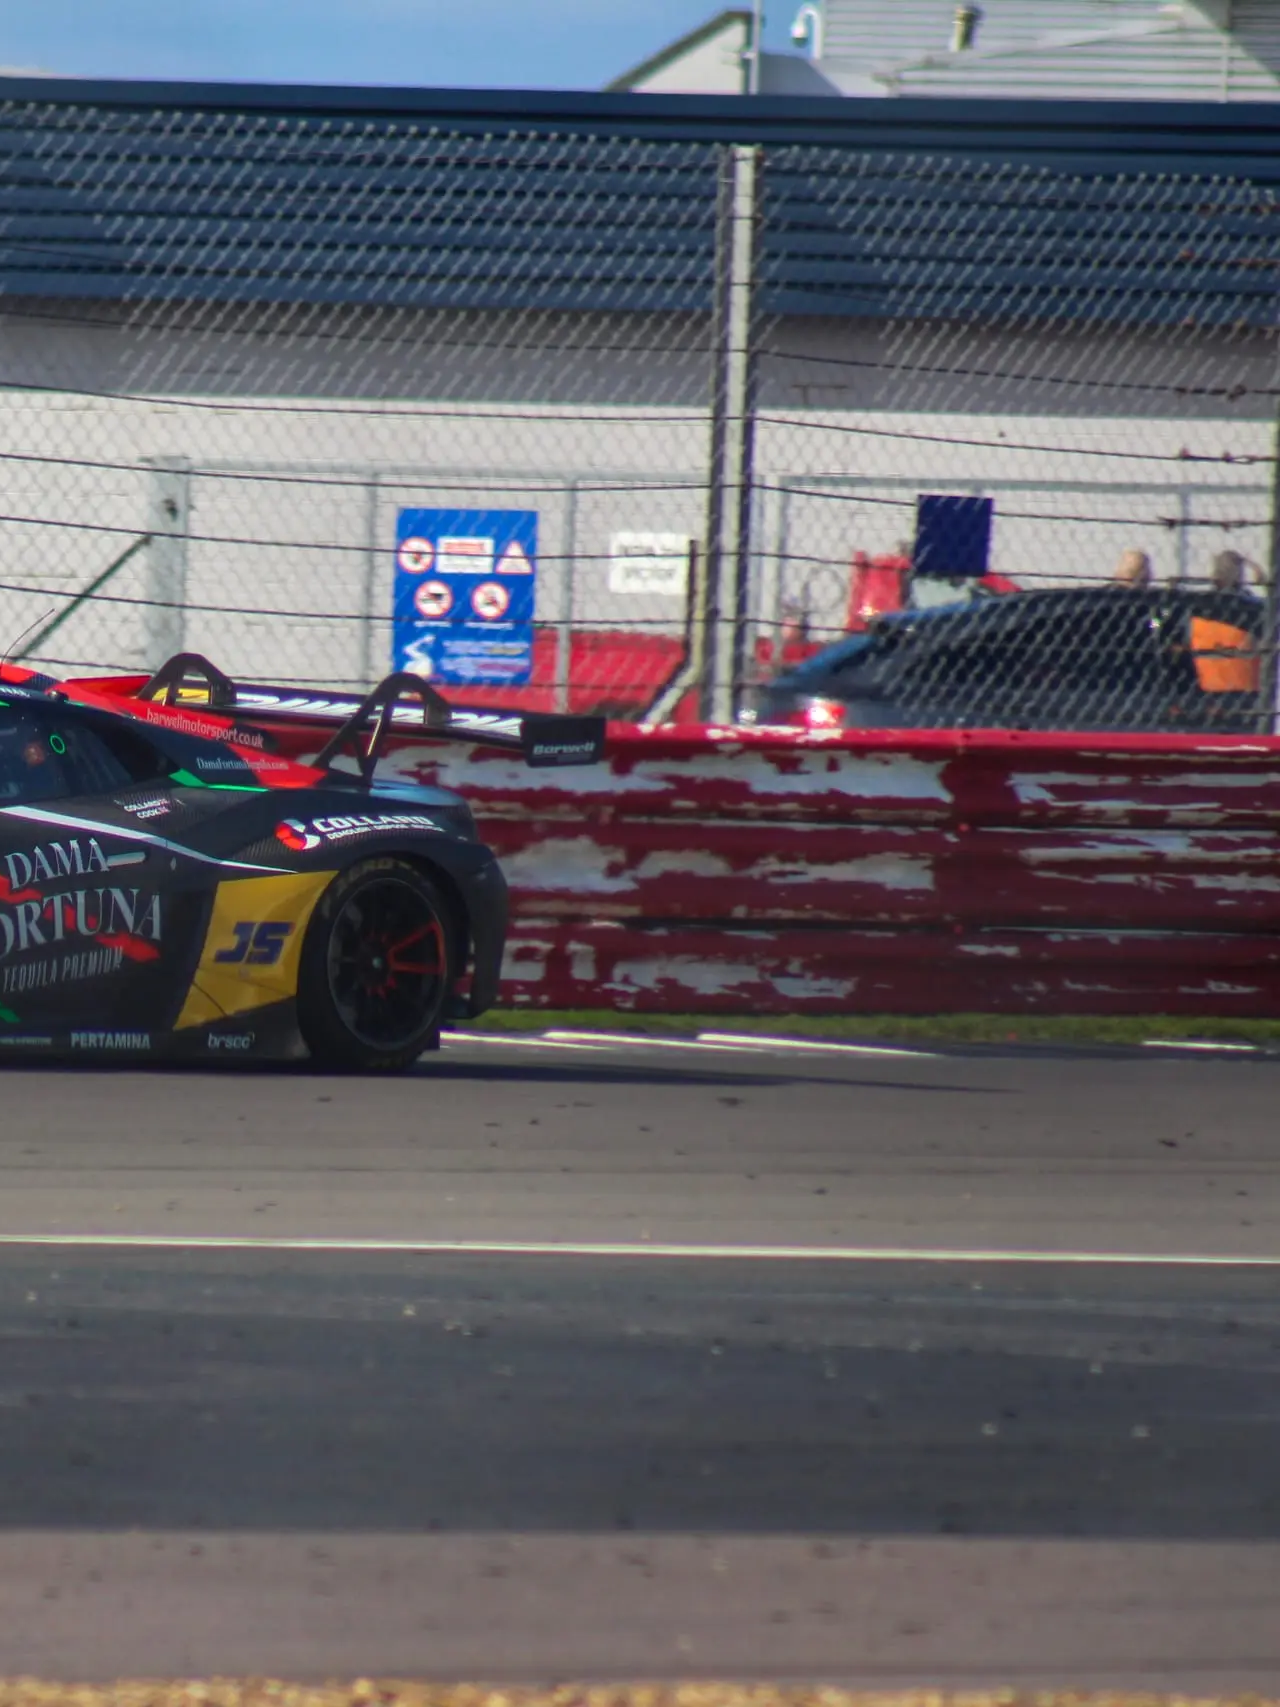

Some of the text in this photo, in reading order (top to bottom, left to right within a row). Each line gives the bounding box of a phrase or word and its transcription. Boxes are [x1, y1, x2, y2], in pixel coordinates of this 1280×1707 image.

[146, 707, 264, 749] barwellmotorsport.co.uk
[312, 815, 435, 834] COLLARD
[4, 837, 111, 890] DAMA
[214, 921, 296, 965] JS
[2, 946, 124, 993] TEQUILA PREMIUM
[70, 1032, 151, 1050] PERTAMINA
